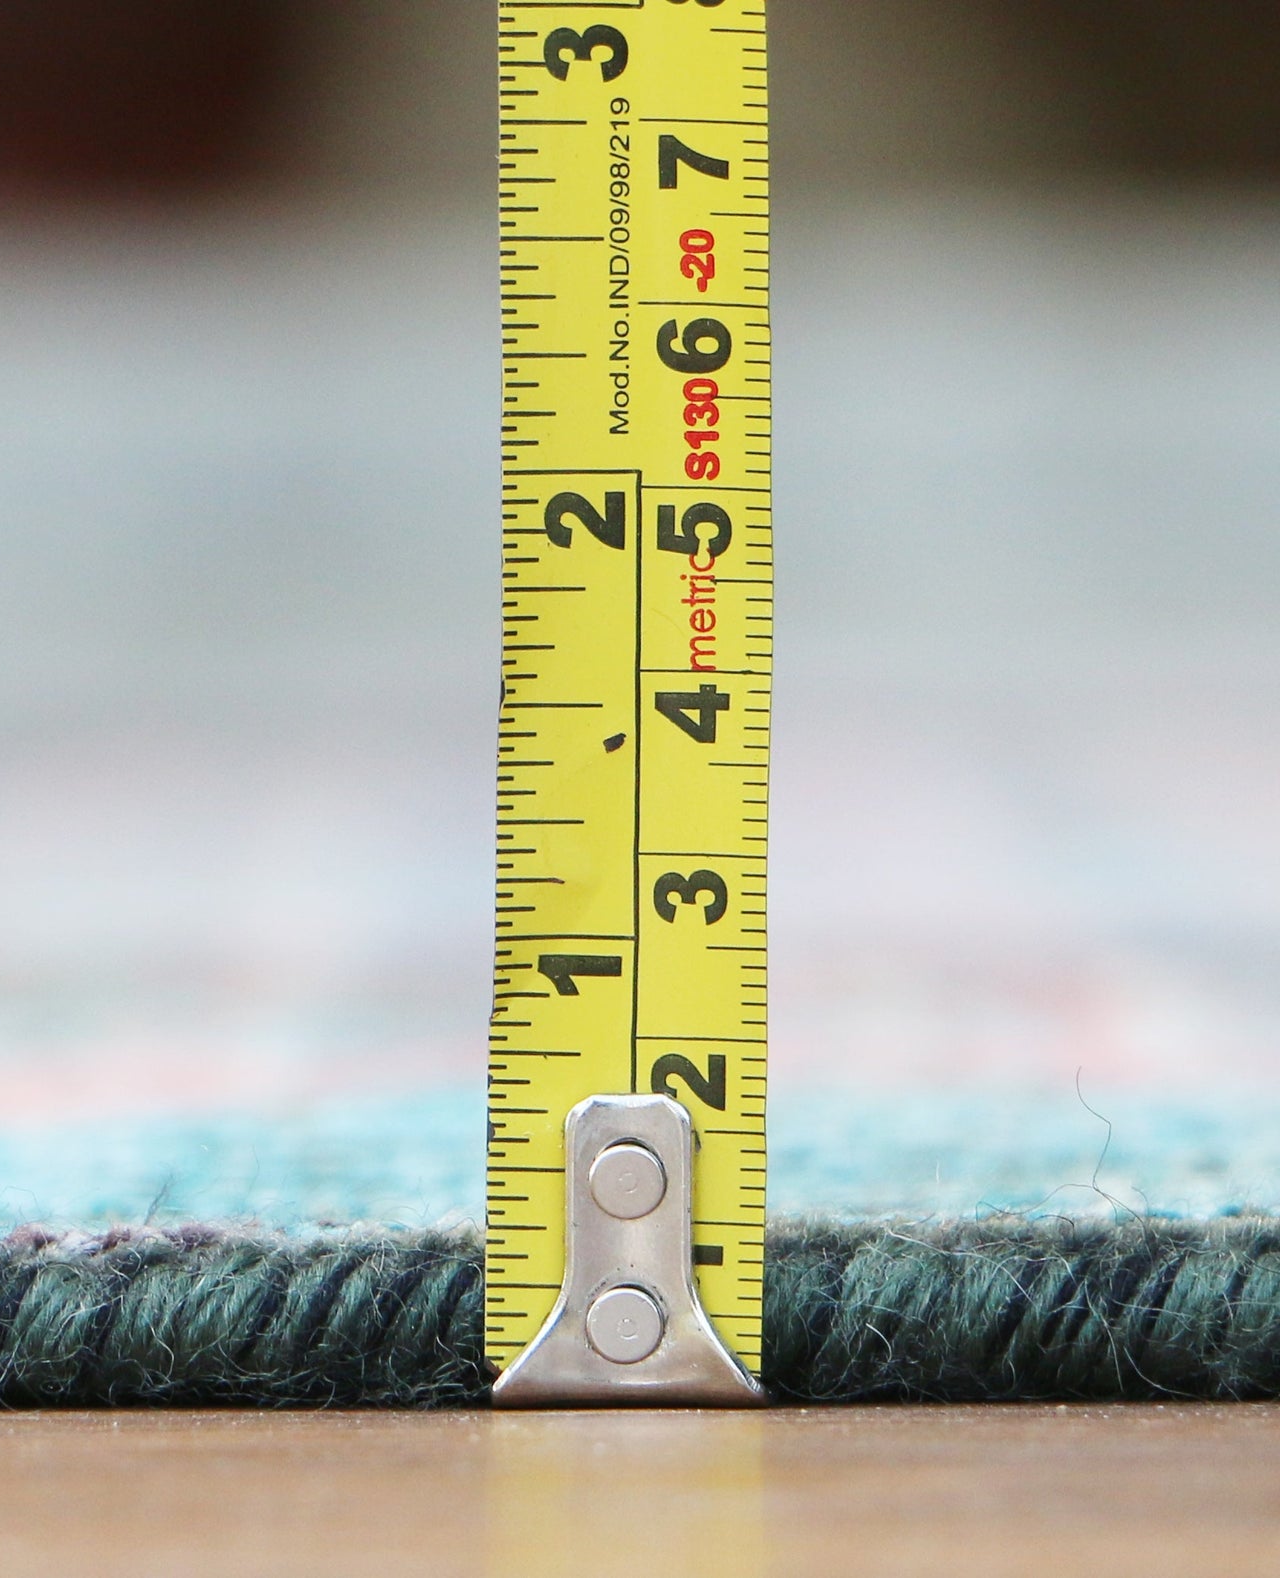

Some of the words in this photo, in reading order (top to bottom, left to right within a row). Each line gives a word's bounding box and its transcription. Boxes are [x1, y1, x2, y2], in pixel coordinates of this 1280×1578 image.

[543, 24, 628, 82] 3
[658, 134, 729, 189] 7
[609, 97, 630, 435] Mod.No.IND/09/98/219
[656, 318, 732, 374] 6
[683, 378, 720, 480] S130
[544, 491, 625, 550] 2
[657, 502, 732, 558] 5
[681, 548, 716, 671] metric
[655, 684, 730, 743] 4
[653, 869, 728, 925] 3
[537, 954, 622, 996] 1
[651, 1053, 726, 1111] 2
